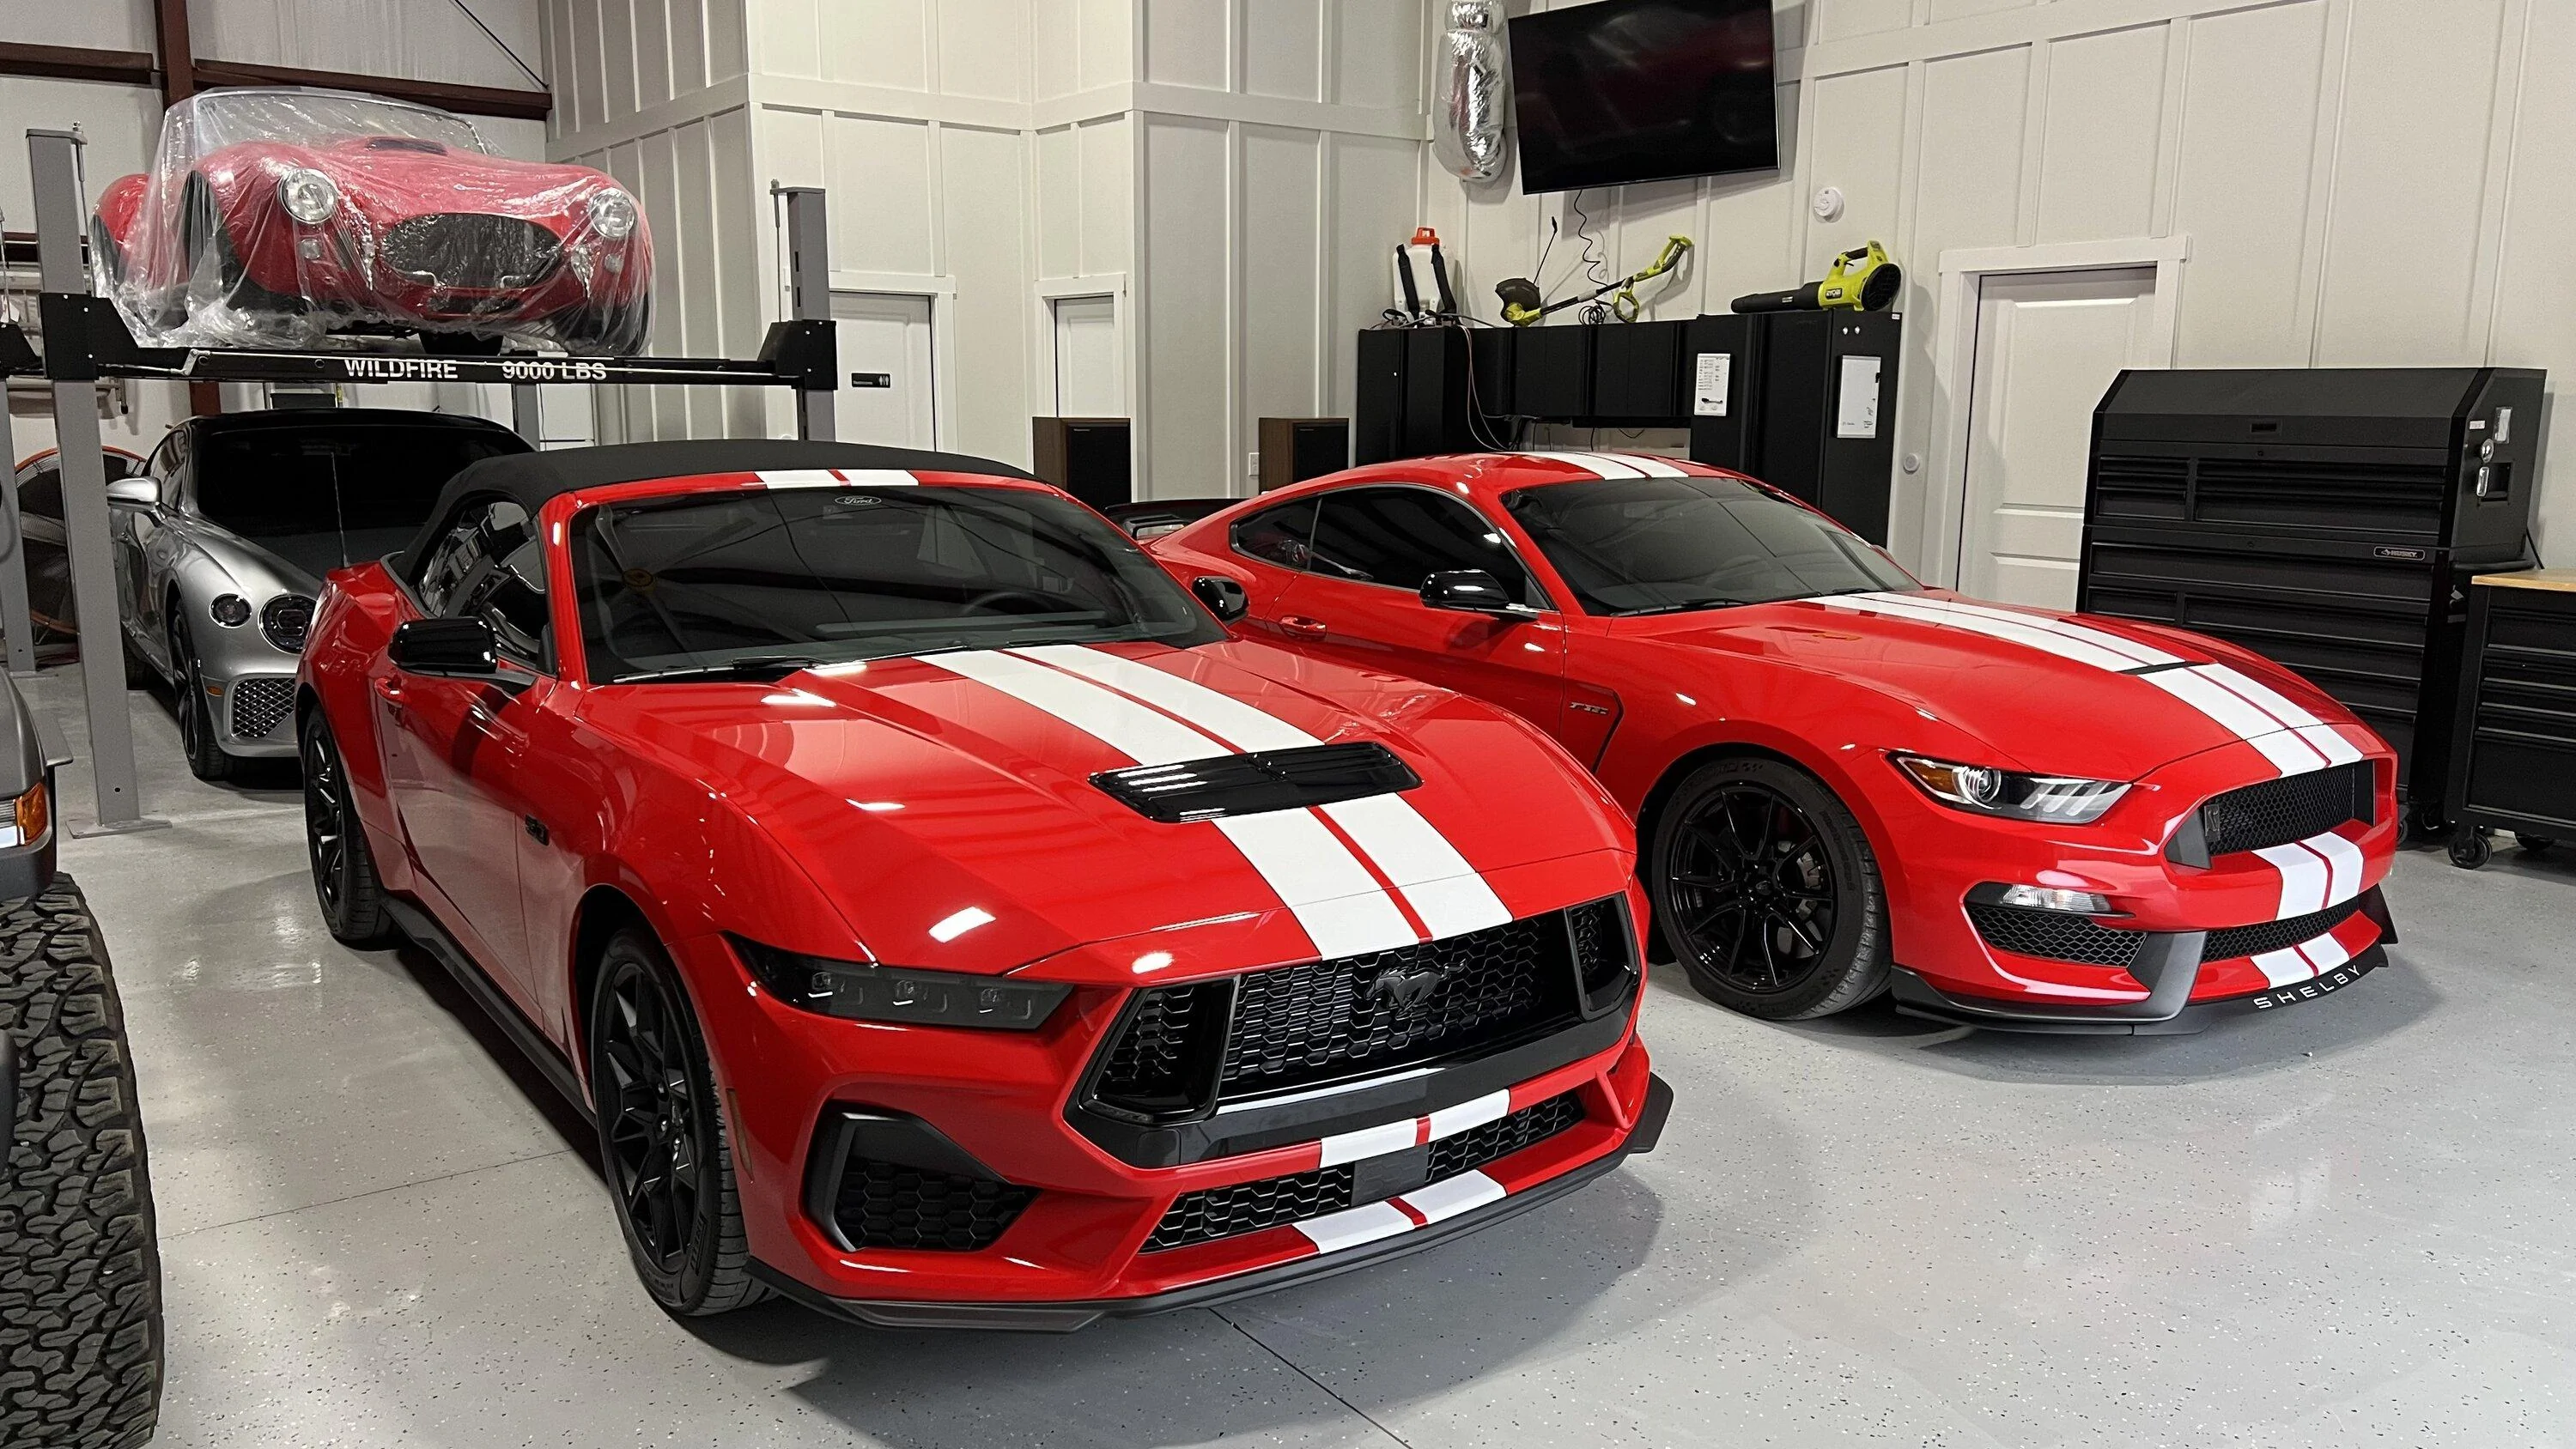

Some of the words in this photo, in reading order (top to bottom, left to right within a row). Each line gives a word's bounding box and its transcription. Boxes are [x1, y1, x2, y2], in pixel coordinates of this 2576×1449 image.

[343, 359, 459, 379] WILDFIRE
[501, 361, 555, 379] 9000
[562, 362, 607, 380] LBS
[843, 496, 873, 505] Ford
[2253, 965, 2360, 1009] SHELBY
